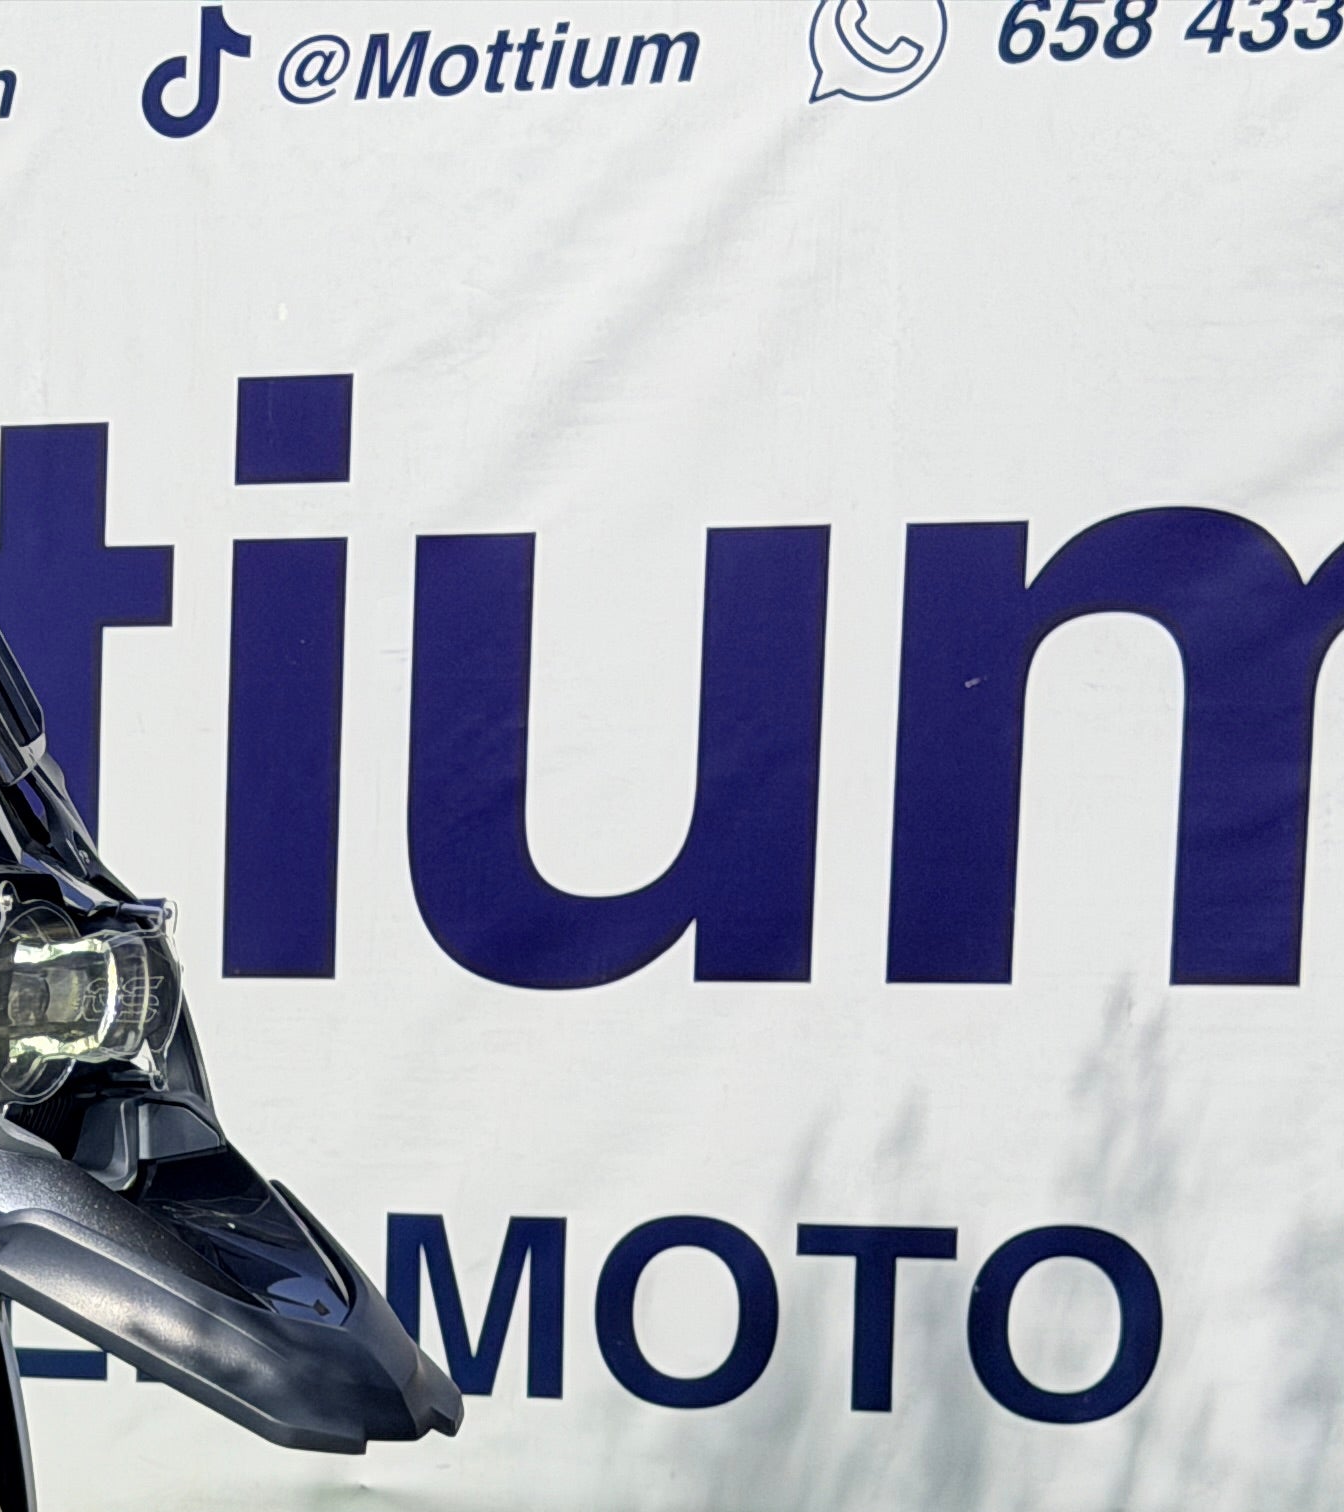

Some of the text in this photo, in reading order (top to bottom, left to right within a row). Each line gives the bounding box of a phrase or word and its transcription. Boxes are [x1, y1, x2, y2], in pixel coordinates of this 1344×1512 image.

[278, 21, 701, 105] @Mottium
[998, 0, 1344, 64] 658 433
[386, 1213, 1164, 1425] MOTO
